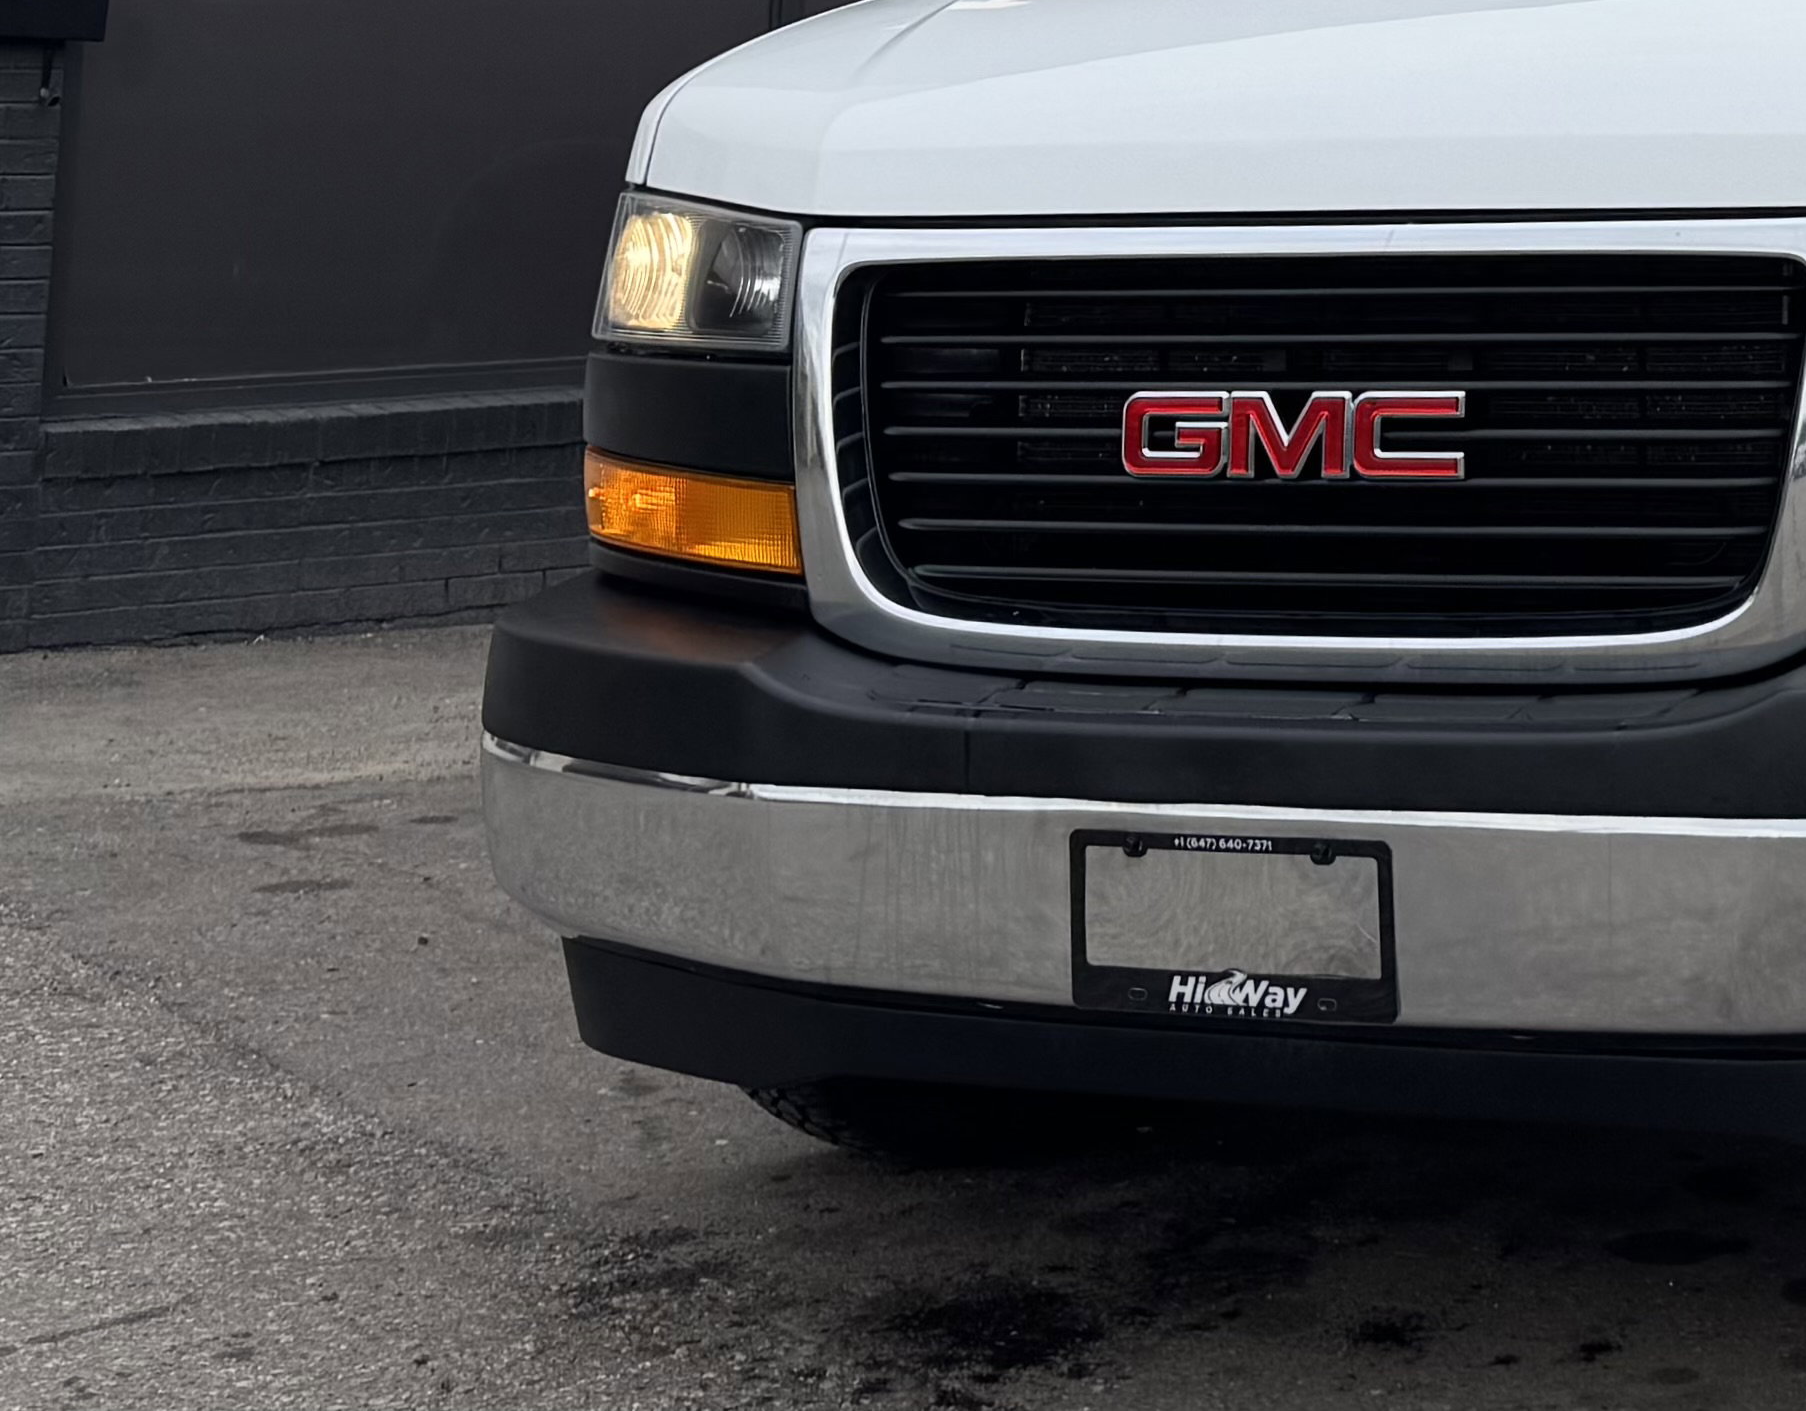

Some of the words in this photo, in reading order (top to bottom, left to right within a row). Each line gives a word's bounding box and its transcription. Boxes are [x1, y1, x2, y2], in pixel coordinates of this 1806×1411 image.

[1122, 390, 1466, 479] GMC
[1186, 837, 1217, 850] (647)
[1219, 838, 1273, 851] 640-7371
[1168, 975, 1207, 1003] Hi
[1232, 979, 1307, 1014] Way
[1169, 1003, 1213, 1014] AUTO
[1227, 1007, 1281, 1018] SALES
